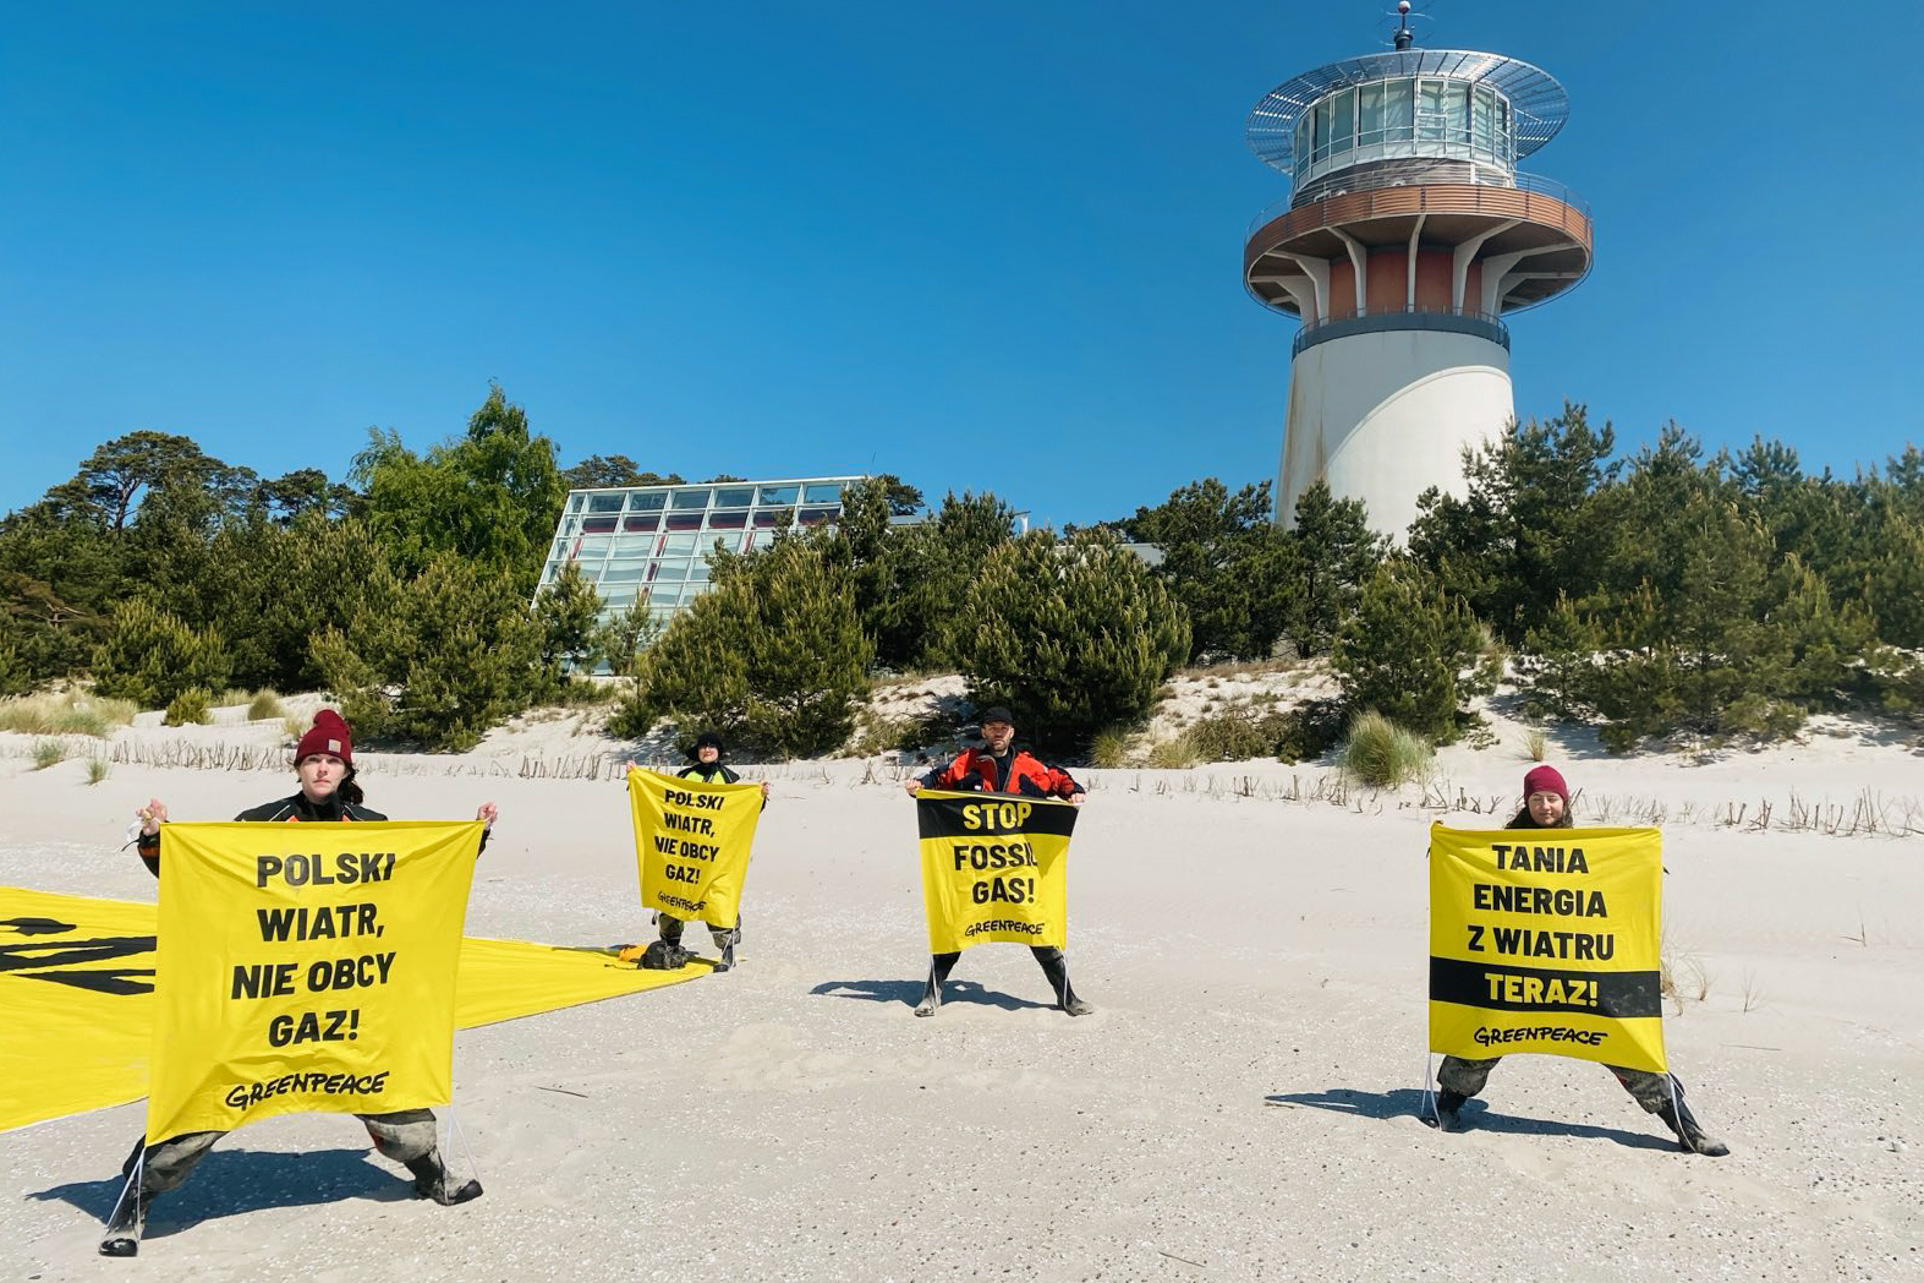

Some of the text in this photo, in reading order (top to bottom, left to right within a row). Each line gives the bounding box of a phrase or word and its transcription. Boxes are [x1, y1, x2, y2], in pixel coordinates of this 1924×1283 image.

[664, 789, 724, 811] POLSKI
[664, 813, 715, 837] WIATR,
[962, 802, 1032, 830] STOP
[654, 836, 719, 862] NIE OBCY
[1491, 844, 1590, 874] TANIA
[256, 853, 396, 888] POLSKI
[665, 864, 700, 884] GAZ!
[972, 877, 1034, 904] GAS!
[1473, 883, 1608, 918] ENERGIA
[256, 903, 385, 942] WIATR,
[964, 919, 1046, 937] GREENPEACE
[1467, 925, 1615, 961] Z WIATRU
[230, 951, 397, 1000] NIE OBCY
[1484, 972, 1599, 1007] TERAZ!
[268, 1009, 361, 1048] GAZ!
[1473, 1026, 1609, 1047] GREENPEACE
[225, 1070, 390, 1111] GREENPEACE
